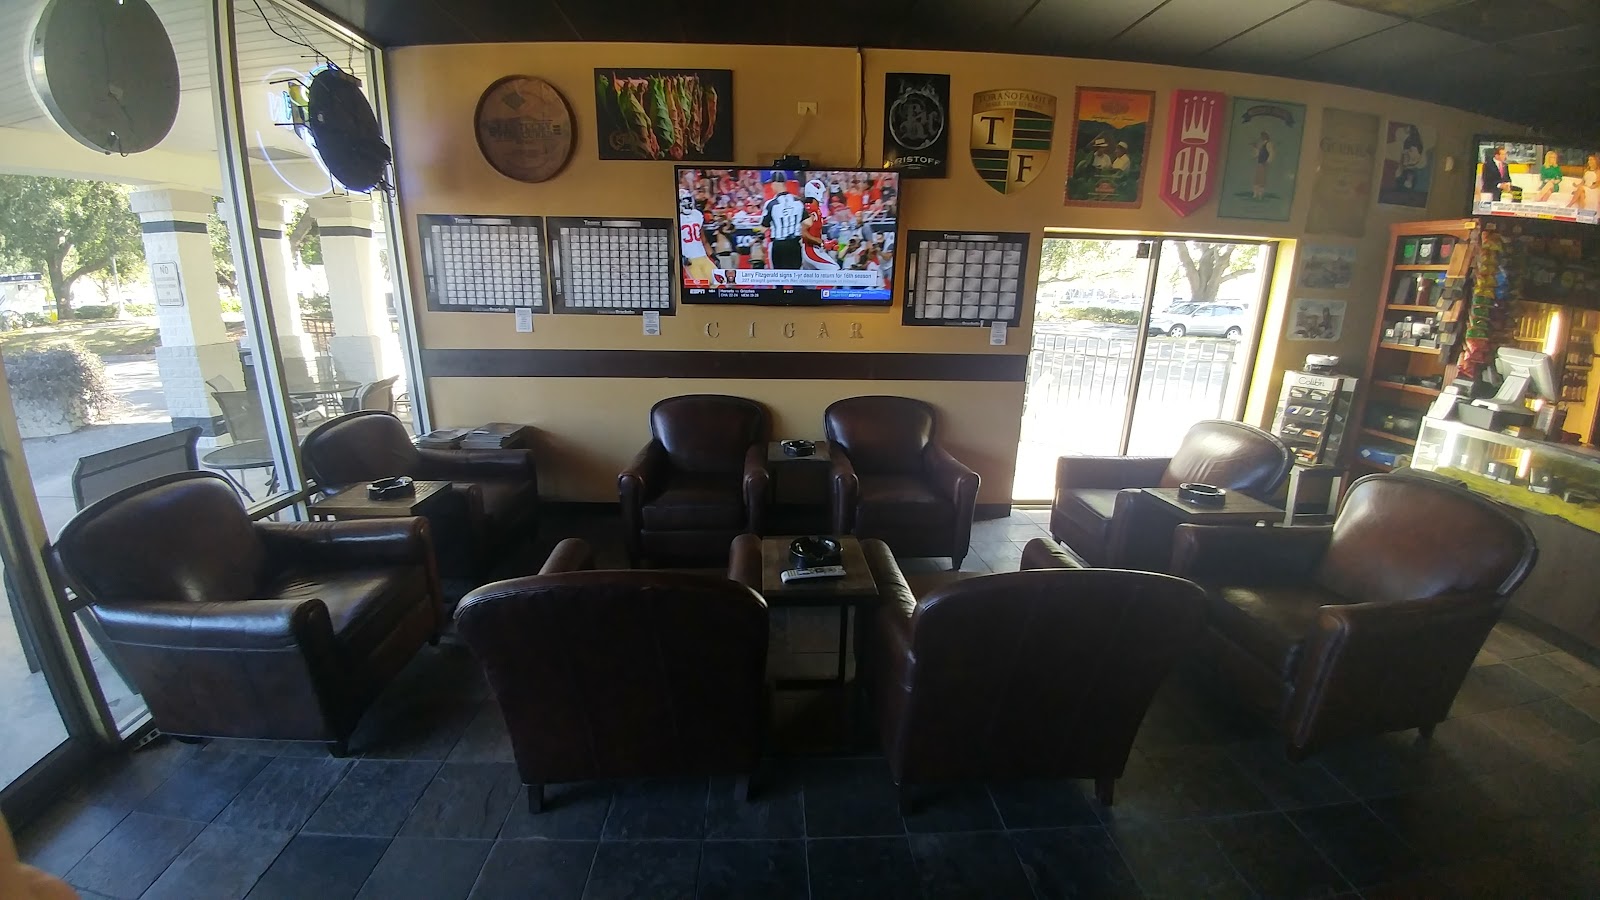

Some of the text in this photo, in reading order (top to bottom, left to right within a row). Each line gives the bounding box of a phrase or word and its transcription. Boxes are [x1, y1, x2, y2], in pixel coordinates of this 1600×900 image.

[979, 91, 1018, 103] TORAÑO
[980, 116, 1004, 145] T
[893, 156, 941, 166] RISTOFF
[1016, 154, 1033, 182] F
[681, 223, 701, 243] 30
[159, 265, 169, 275] NO
[741, 272, 754, 280] Larry
[755, 272, 778, 280] Fitzgerald
[793, 272, 803, 280] 1-yr
[705, 321, 864, 339] CIGAR
